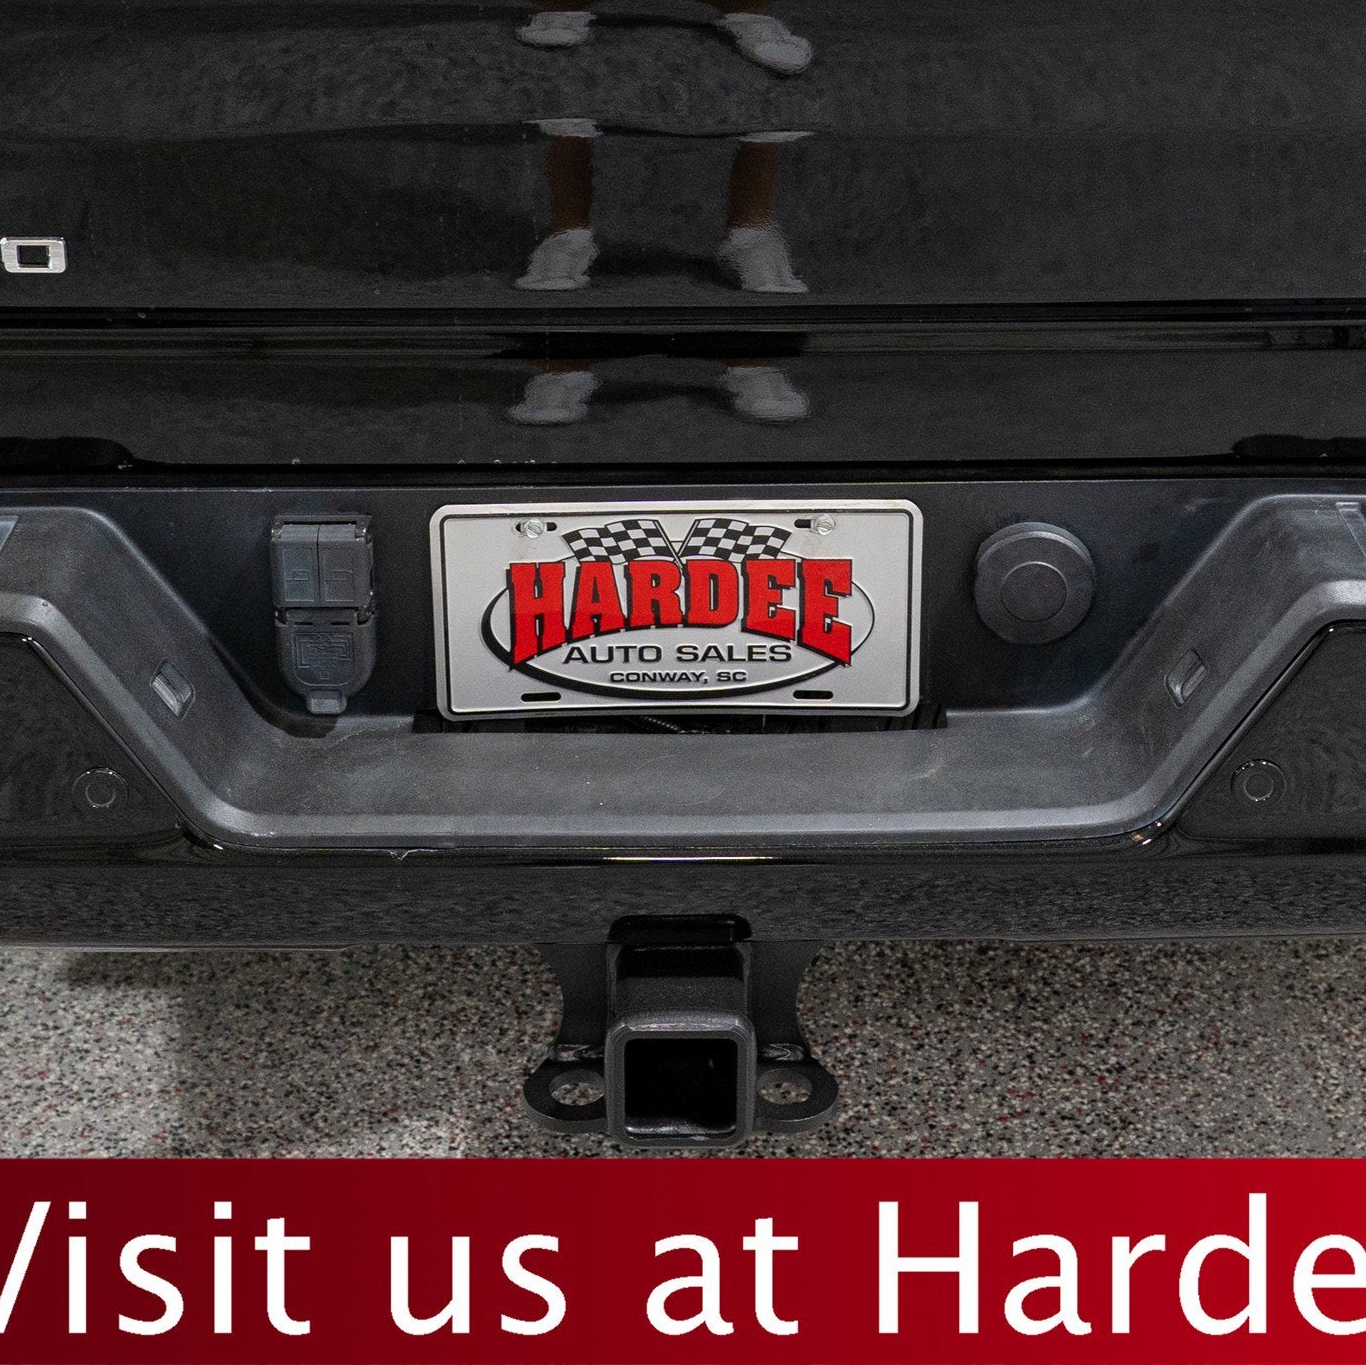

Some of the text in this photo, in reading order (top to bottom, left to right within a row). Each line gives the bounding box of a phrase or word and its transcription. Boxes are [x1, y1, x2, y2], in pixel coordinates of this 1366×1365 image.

[506, 558, 853, 669] HARDEE
[562, 643, 793, 665] AUTO SALES
[610, 669, 748, 685] CONWAY, SC
